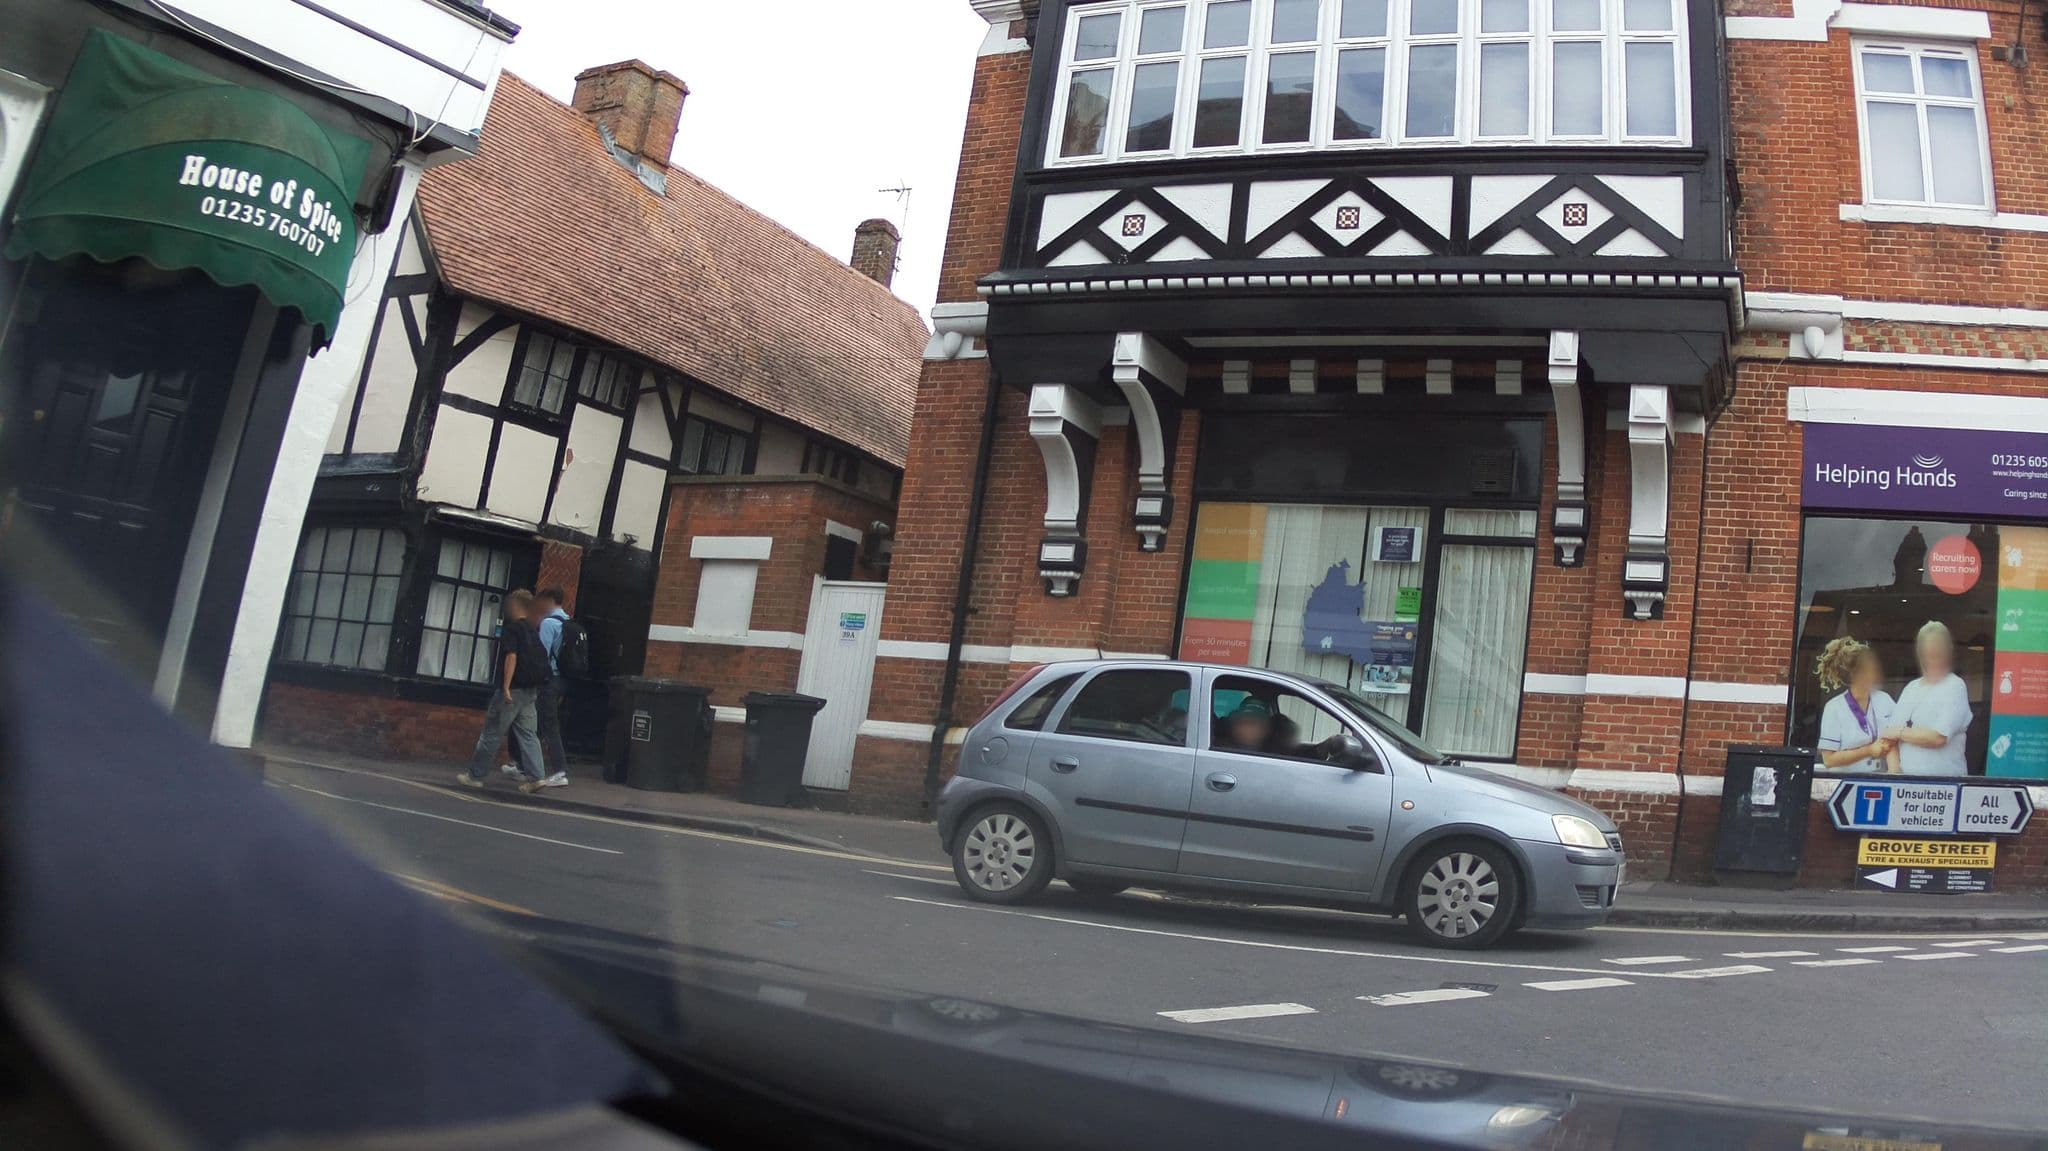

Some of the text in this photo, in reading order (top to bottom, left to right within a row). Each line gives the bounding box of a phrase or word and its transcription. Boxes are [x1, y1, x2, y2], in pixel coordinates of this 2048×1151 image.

[179, 154, 342, 243] House of Spice
[201, 196, 325, 256] 01235 760707
[1992, 454, 2048, 468] 01235 605
[1816, 463, 1957, 490] Helping Hands
[2004, 488, 2048, 500] Caring since
[1933, 552, 1976, 565] Recruiting
[1931, 565, 1979, 574] carers now!
[1185, 636, 1248, 648] From 30 minutes
[1198, 648, 1232, 657] per week
[1896, 788, 1954, 800] Unsuitable
[1980, 795, 1999, 808] All
[1904, 803, 1945, 815] for long
[1901, 815, 1944, 826] vehicles
[1966, 812, 2009, 825] routes
[1867, 841, 1990, 855] GROVE STREET
[1898, 857, 1935, 865] EXHAUST
[1938, 858, 1989, 866] SPECIALISTS
